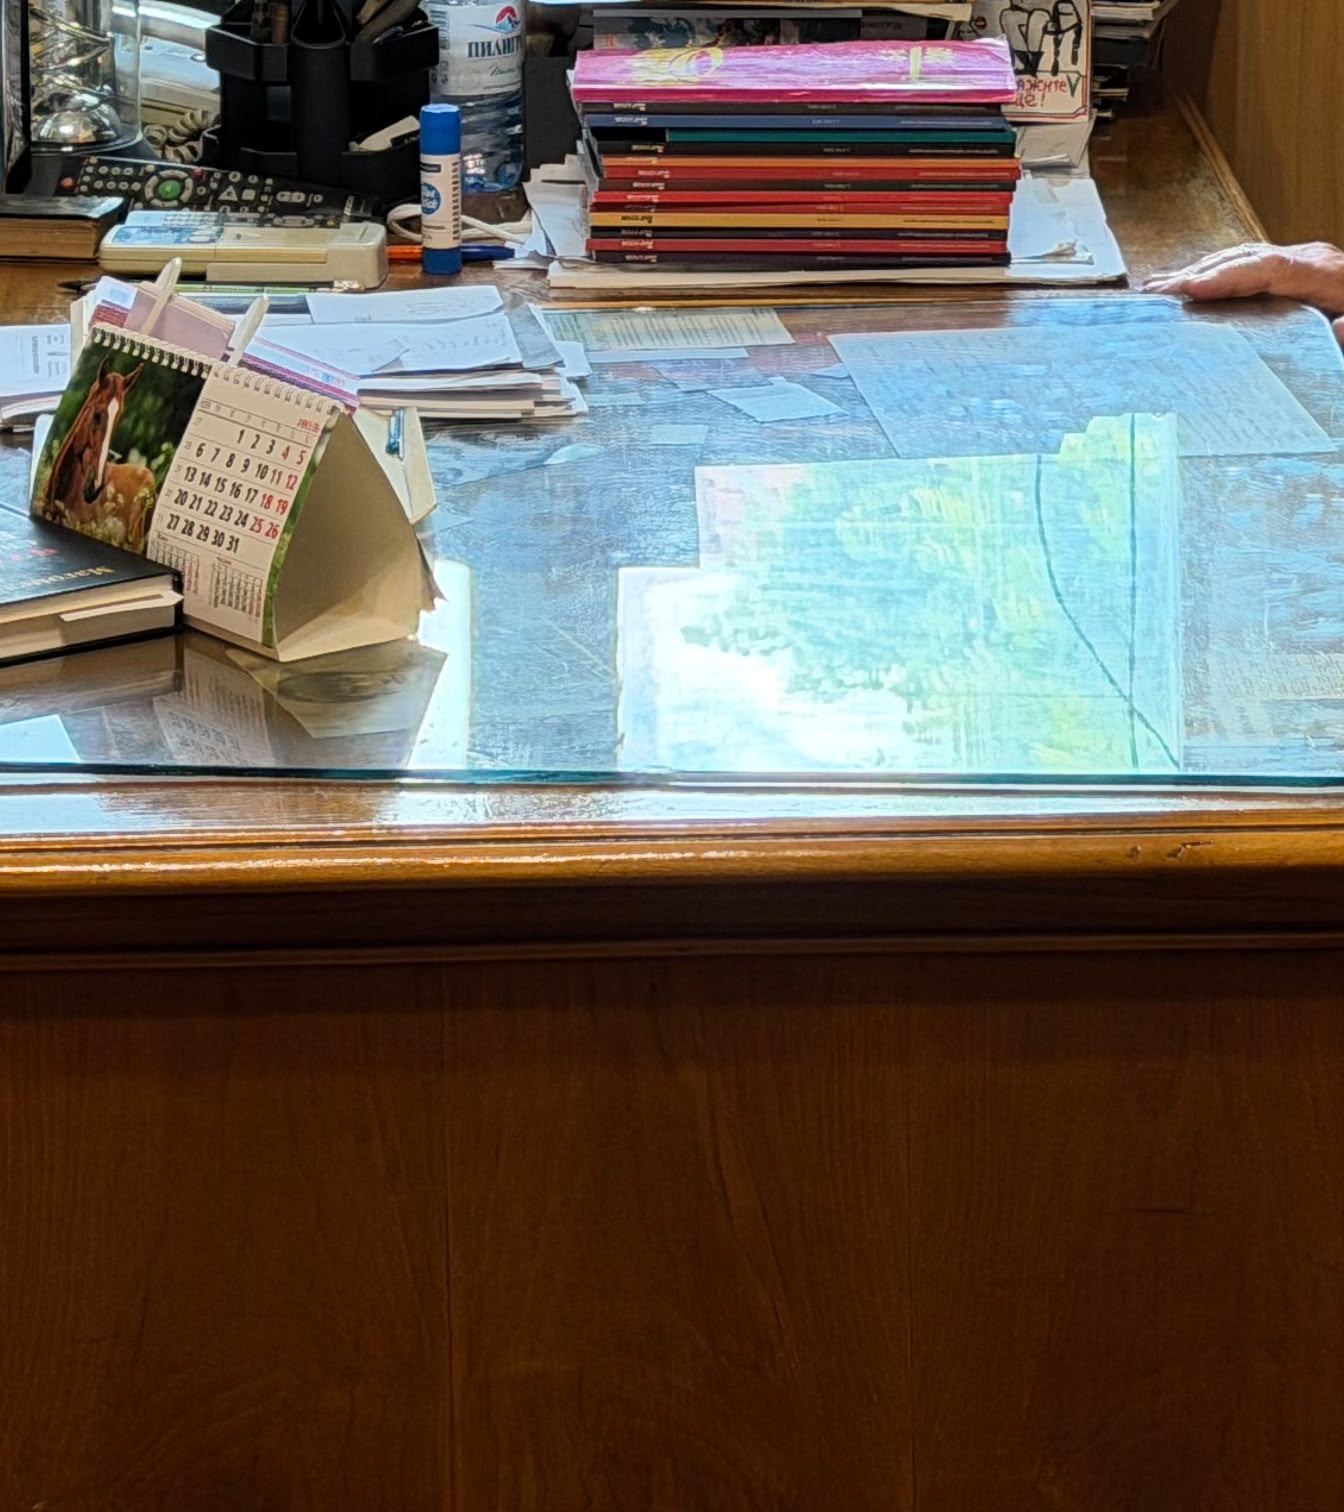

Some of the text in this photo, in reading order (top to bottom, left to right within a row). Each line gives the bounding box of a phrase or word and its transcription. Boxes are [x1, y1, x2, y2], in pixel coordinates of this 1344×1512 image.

[196, 443, 205, 458] 6
[210, 448, 220, 462] 7
[226, 453, 236, 468] 8
[241, 459, 250, 473] 9
[256, 463, 268, 479] 10
[270, 468, 282, 483] 11
[285, 474, 298, 490] 12
[237, 429, 244, 444] 1
[251, 434, 260, 449] 2
[266, 439, 275, 454] 3
[282, 446, 290, 460] 4
[296, 450, 306, 464] 5
[174, 489, 188, 505] 20
[189, 495, 202, 511] 21
[204, 500, 217, 516] 22
[219, 505, 233, 521] 23
[235, 511, 249, 527] 24
[249, 516, 263, 533] 25
[265, 522, 279, 539] 26
[184, 467, 197, 482] 13
[199, 472, 212, 487] 14
[215, 477, 228, 493] 15
[230, 482, 242, 498] 16
[245, 488, 258, 504] 17
[260, 493, 273, 509] 18
[276, 499, 288, 515] 19
[167, 513, 180, 531] 27
[181, 520, 195, 536] 28
[197, 525, 209, 541] 29
[211, 529, 225, 546] 30
[226, 536, 240, 553] 31
